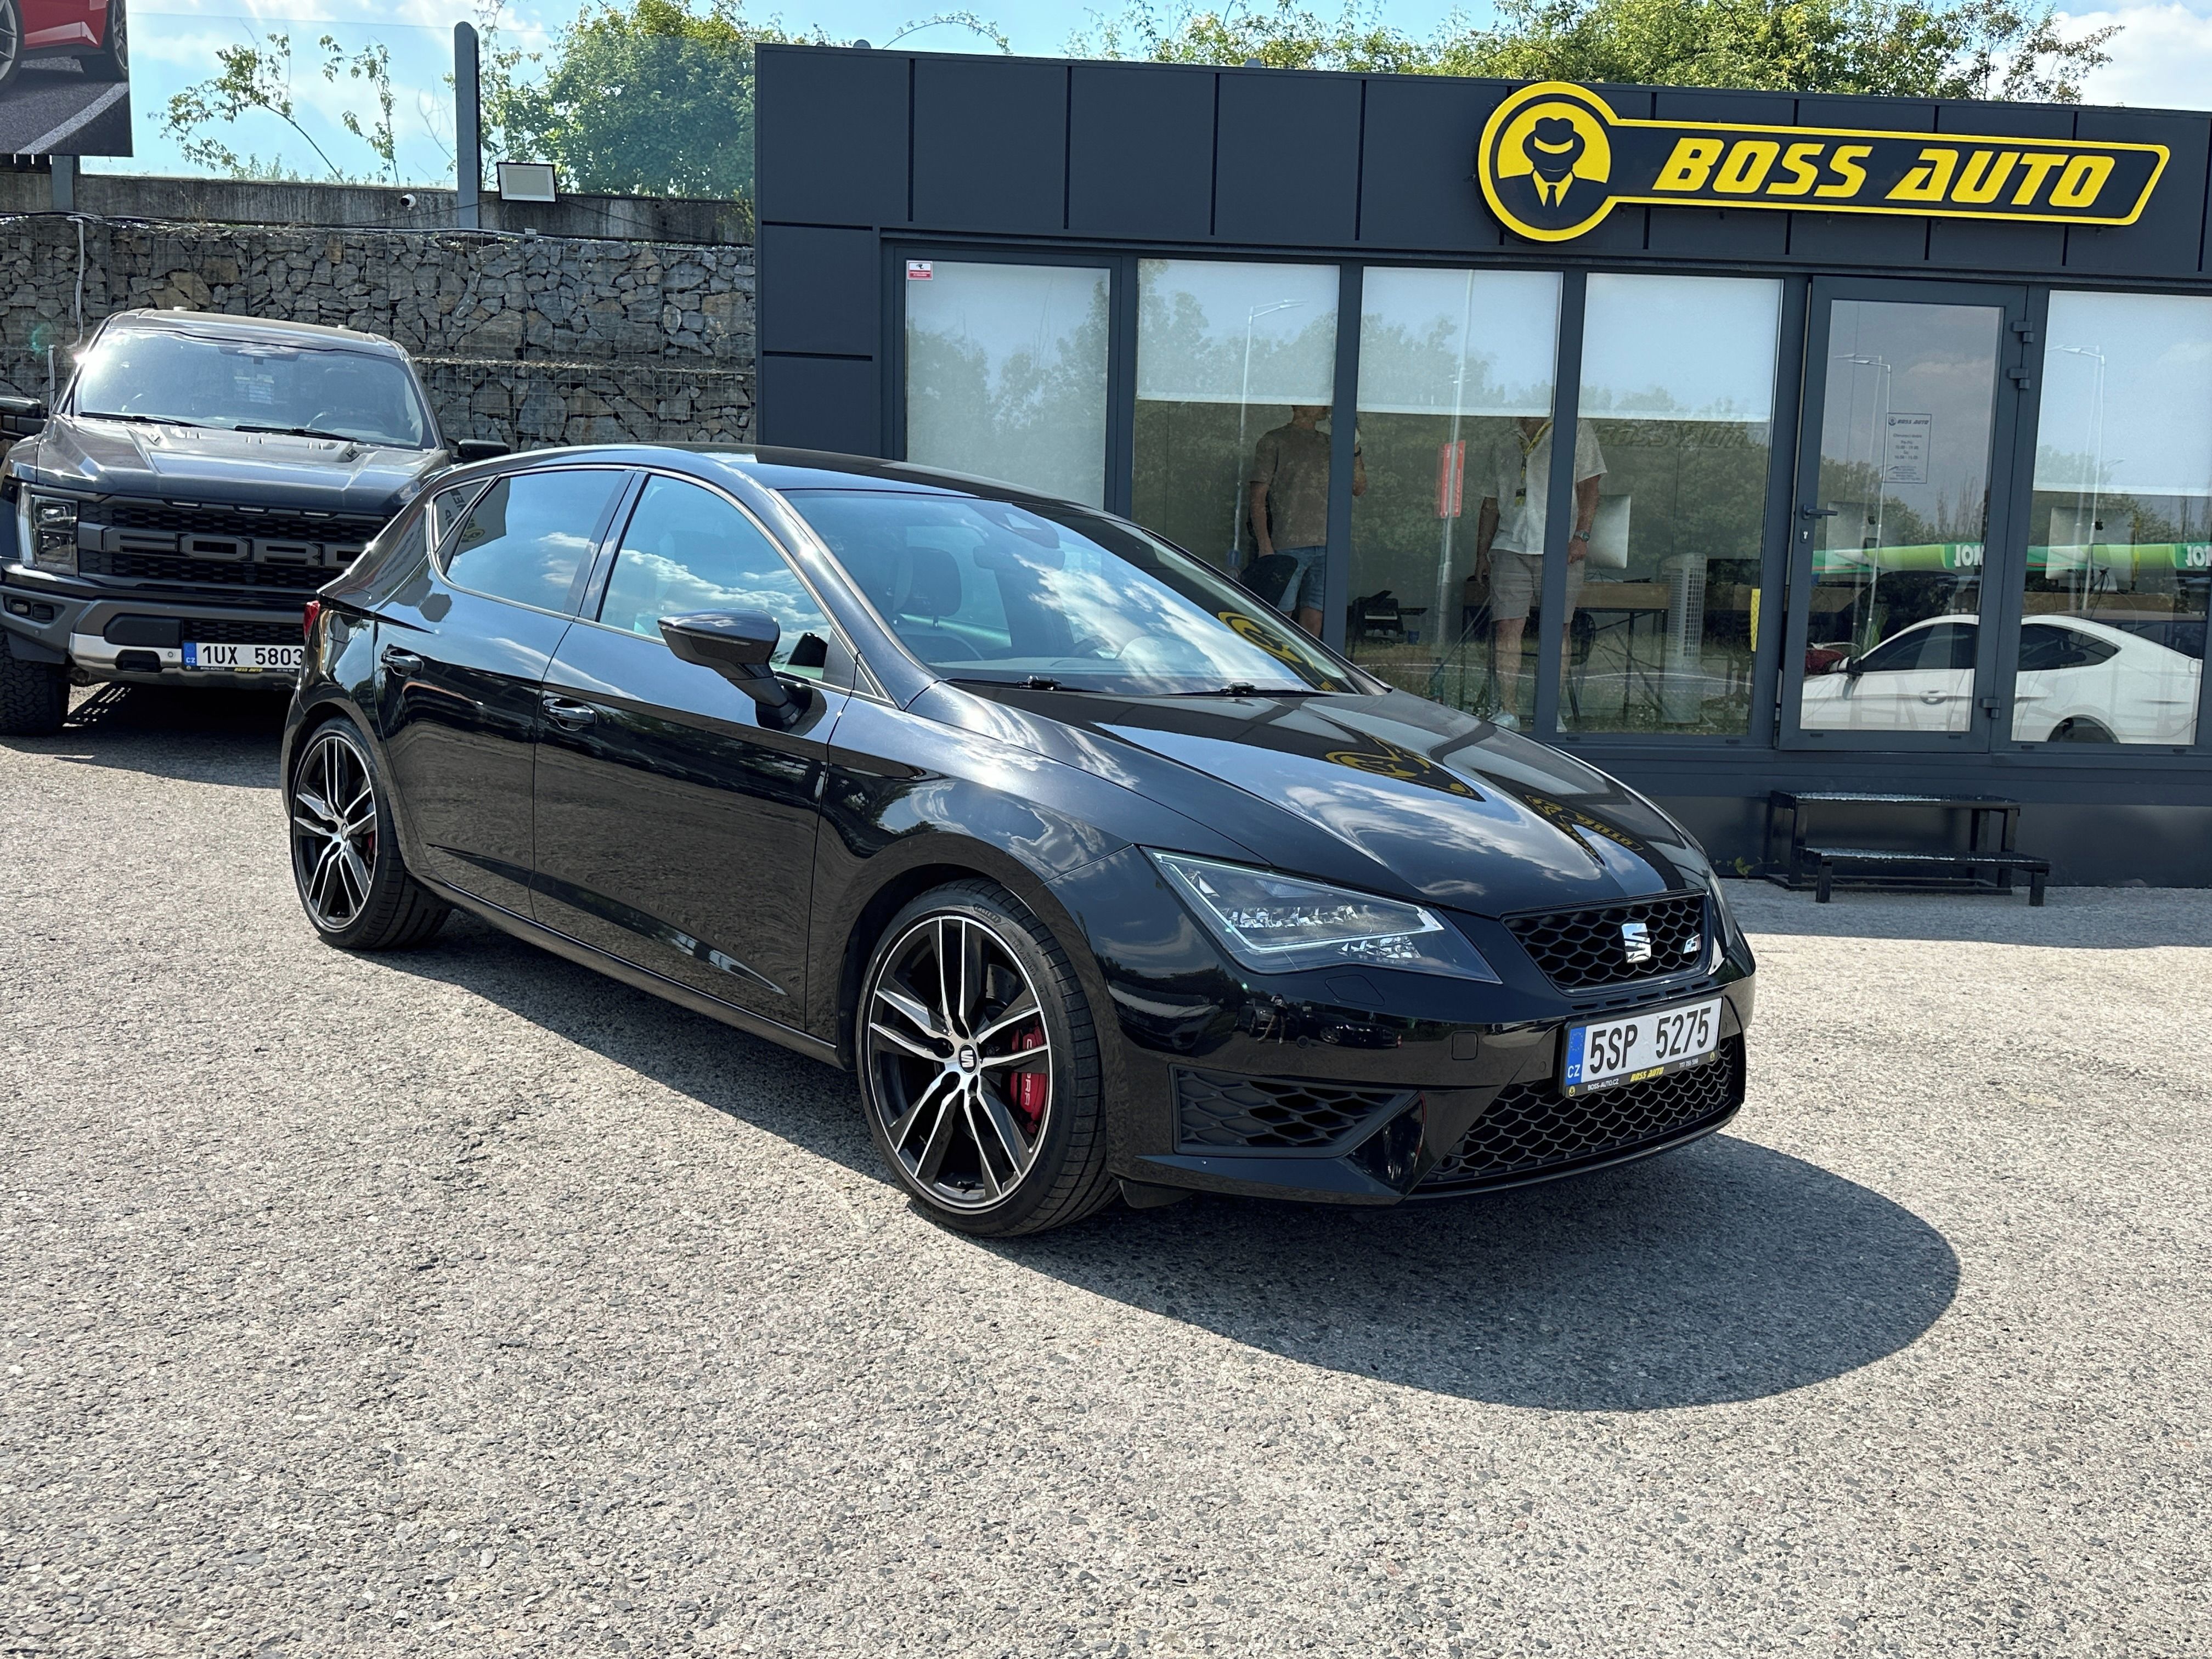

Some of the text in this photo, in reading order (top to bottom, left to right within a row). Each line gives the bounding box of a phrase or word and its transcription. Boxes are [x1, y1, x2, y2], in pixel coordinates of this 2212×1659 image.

[1652, 138, 2115, 207] BOSS AUTO
[203, 646, 302, 665] 1UX 5803
[1590, 1007, 1711, 1074] 5SP 5275
[1567, 1064, 1581, 1079] CZ
[1588, 1066, 1664, 1091] BOSS-AUTO.CZ BOSS AUTO
